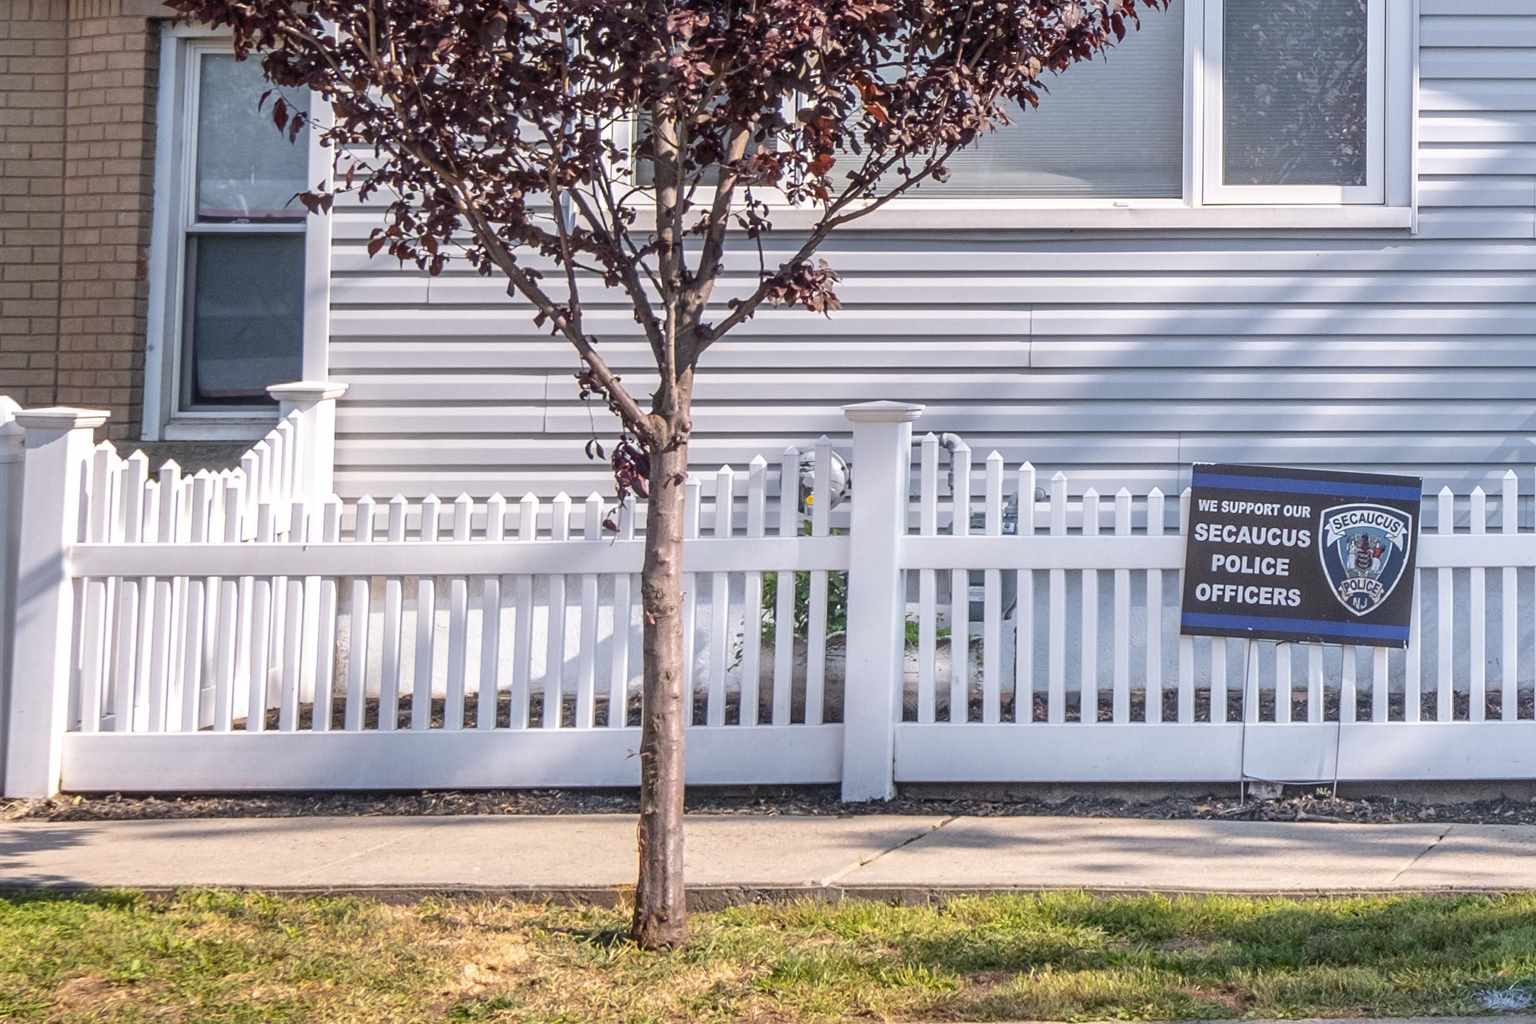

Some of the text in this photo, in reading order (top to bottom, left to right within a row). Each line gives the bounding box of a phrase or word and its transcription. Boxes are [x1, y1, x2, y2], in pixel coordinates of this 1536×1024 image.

[1198, 499, 1311, 518] WE SUPPORT OUR
[1332, 513, 1401, 533] SECAUCUS
[1194, 523, 1311, 548] SECAUCUS
[1211, 554, 1290, 576] POLICE
[1195, 583, 1301, 607] OFFICERS
[1344, 579, 1380, 593] POLICE
[1352, 597, 1368, 610] NJ
